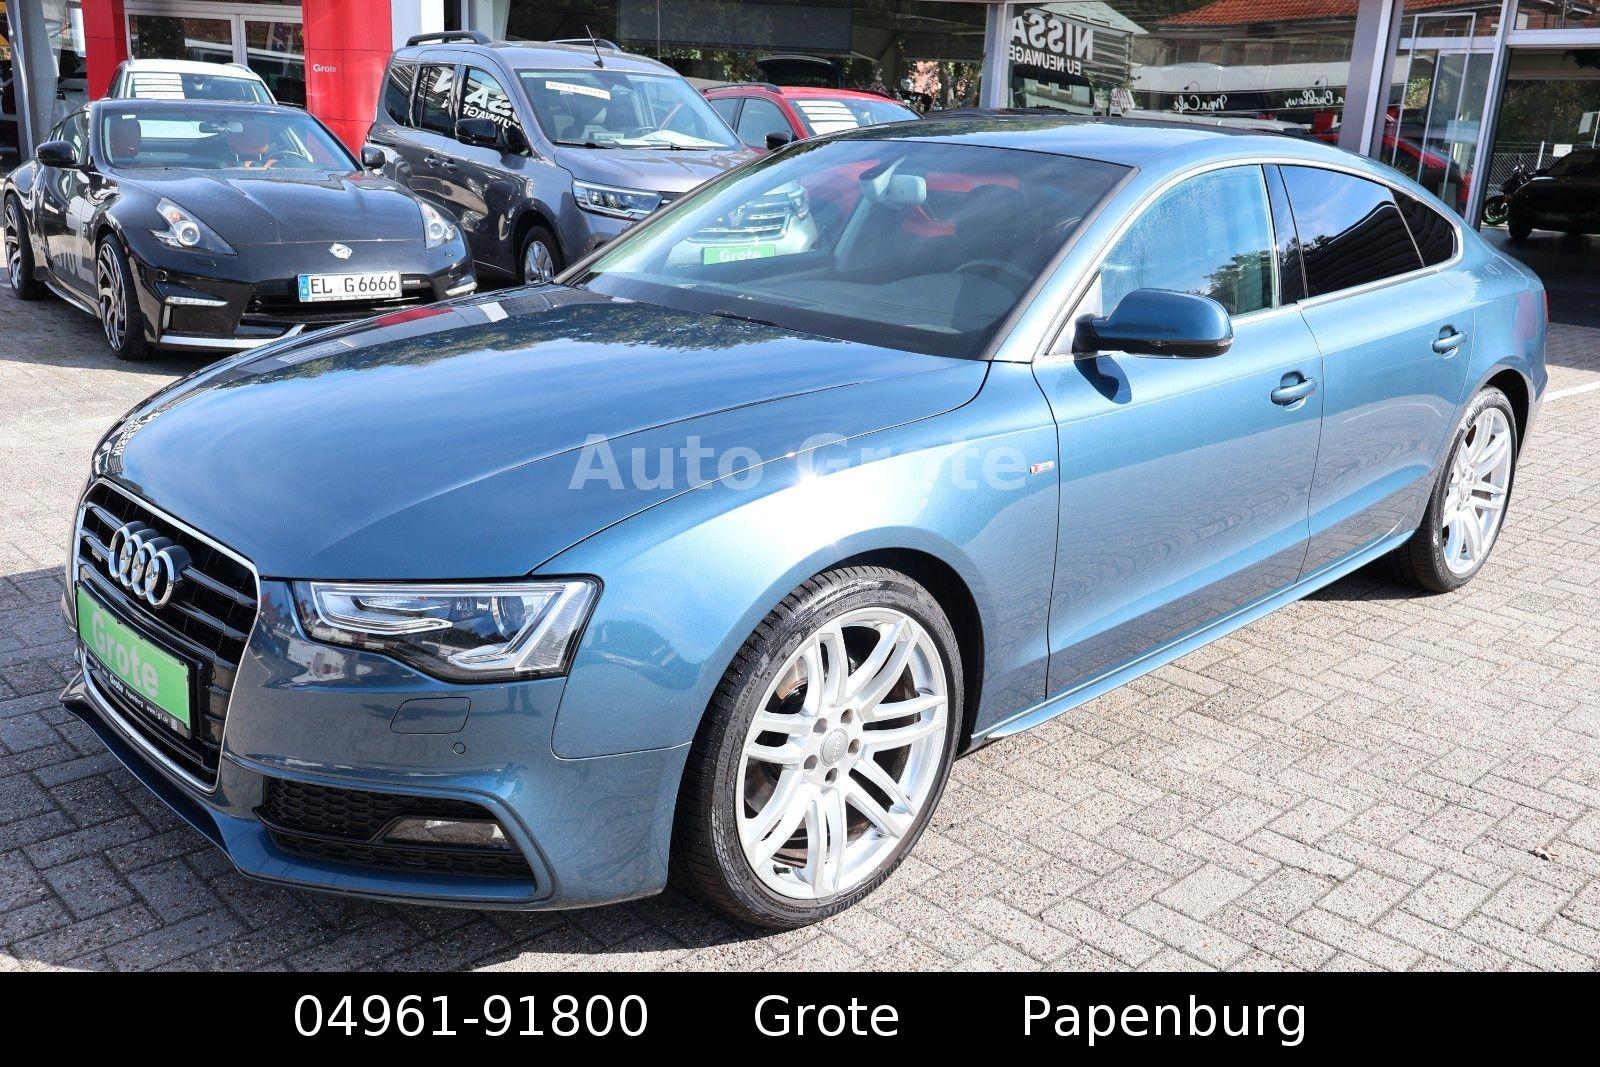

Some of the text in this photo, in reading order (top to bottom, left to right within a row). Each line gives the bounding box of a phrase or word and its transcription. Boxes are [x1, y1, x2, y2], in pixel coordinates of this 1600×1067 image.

[313, 63, 337, 73] Grote
[310, 278, 333, 294] EL
[91, 611, 160, 698] Grote
